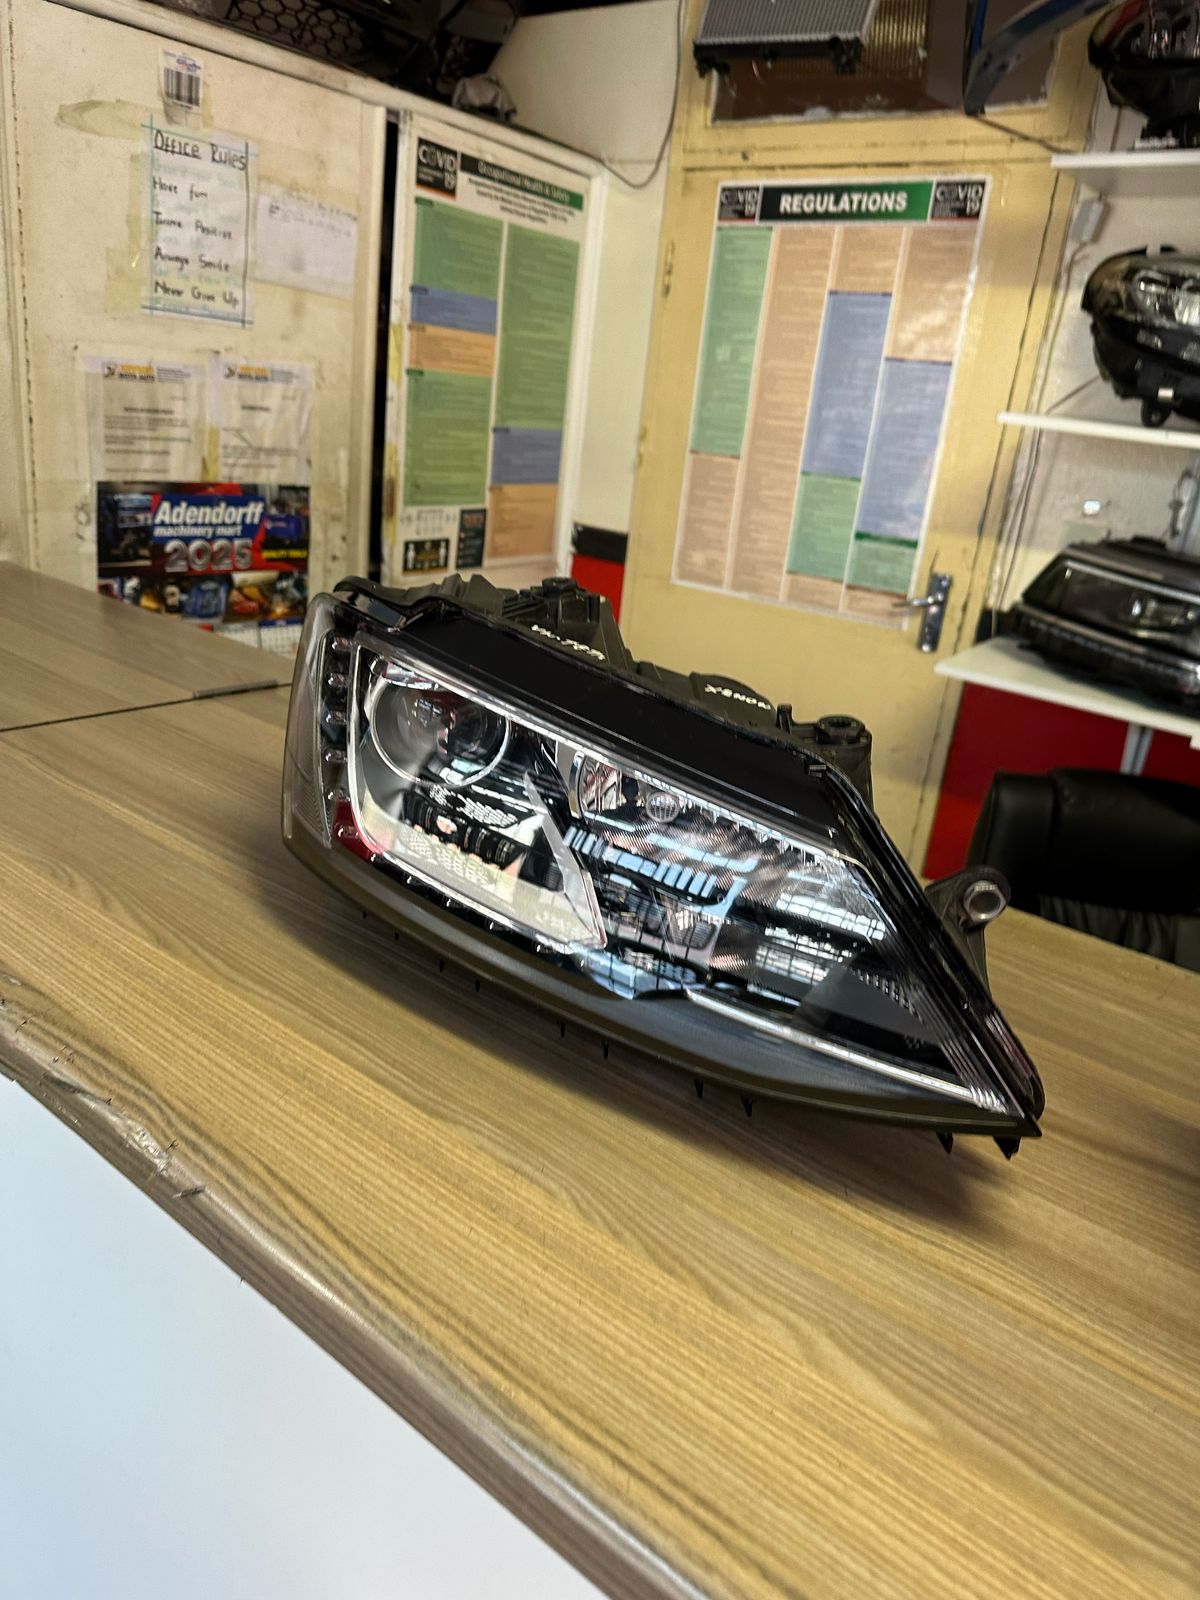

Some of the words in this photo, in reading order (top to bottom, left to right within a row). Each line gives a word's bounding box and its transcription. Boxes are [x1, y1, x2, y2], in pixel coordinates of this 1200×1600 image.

[210, 143, 247, 171] Rules
[419, 146, 456, 171] COVID
[779, 191, 908, 214] REGULATIONS
[936, 183, 984, 201] COVID
[222, 290, 239, 309] Up
[154, 501, 265, 525] Adendorff
[153, 526, 213, 539] machinery
[215, 526, 242, 537] mart
[164, 538, 253, 573] 2025
[704, 683, 772, 711] XENON
